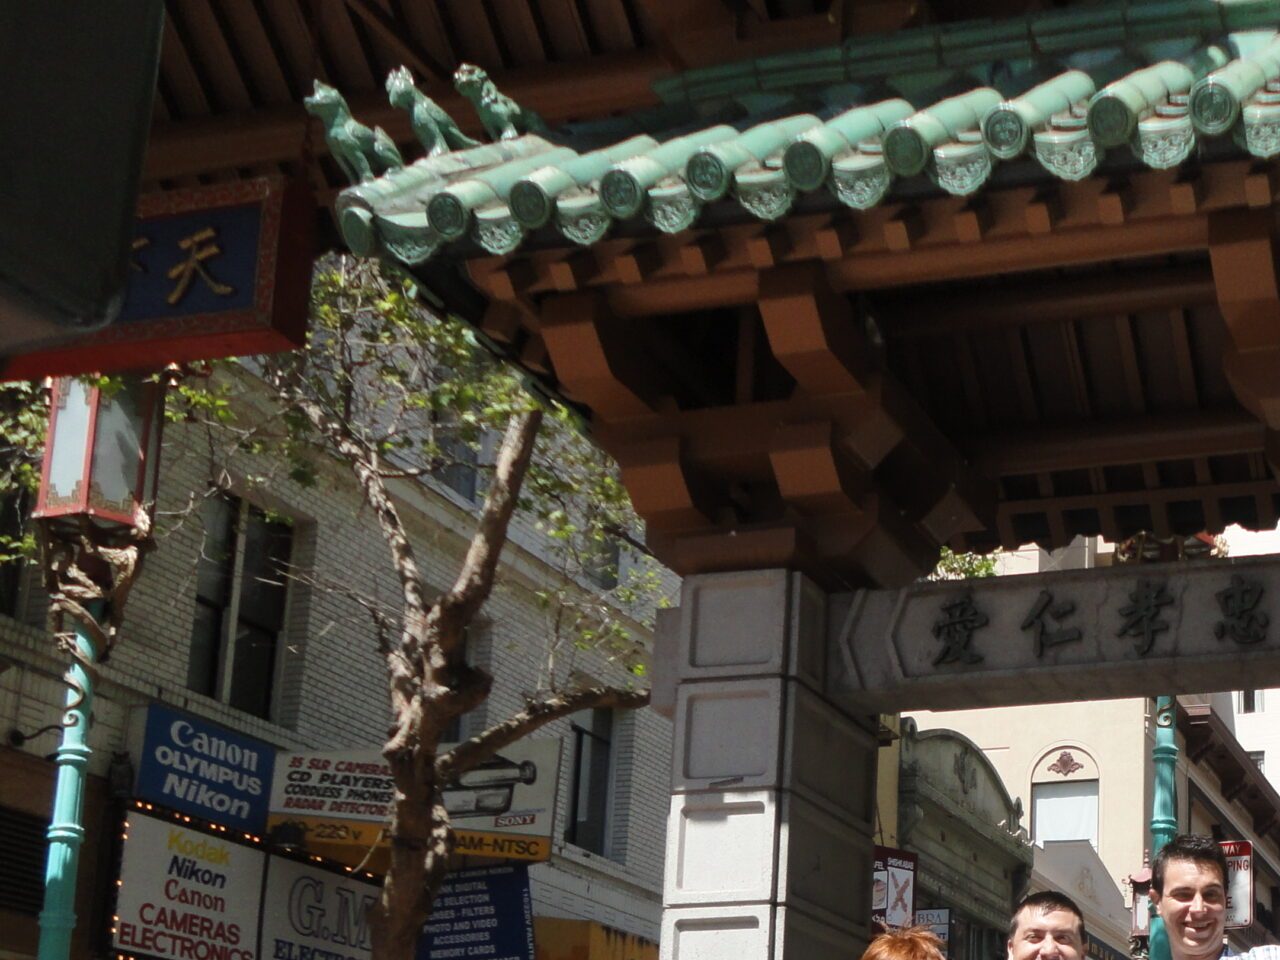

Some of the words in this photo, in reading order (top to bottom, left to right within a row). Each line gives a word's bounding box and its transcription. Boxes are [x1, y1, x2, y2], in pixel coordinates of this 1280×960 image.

[131, 227, 234, 305] 天
[170, 720, 258, 772] Canon
[155, 745, 262, 795] OLYMPUS
[307, 758, 331, 771] SLR
[287, 770, 313, 783] CD
[318, 772, 393, 790] PLAYERS
[162, 772, 250, 819] Nikon
[284, 783, 343, 799] CORDLESS
[283, 797, 326, 811] RADAR
[328, 801, 393, 817] DETECTOR
[498, 815, 535, 826] SONY
[167, 829, 230, 866] Kodak
[168, 855, 226, 889] Nikon
[1227, 859, 1249, 872] PING
[164, 878, 225, 913] Canon
[455, 881, 488, 893] DIGITAL
[444, 893, 490, 906] SELECTION
[462, 906, 496, 917] FILTERS
[139, 902, 241, 945] CAMERAS
[423, 923, 452, 934] PHOTO
[453, 920, 471, 931] AND
[472, 918, 498, 929] VIDEO
[433, 932, 490, 945] ACCESSORIES
[430, 948, 465, 959] MEMORY
[467, 944, 496, 956] CARDS
